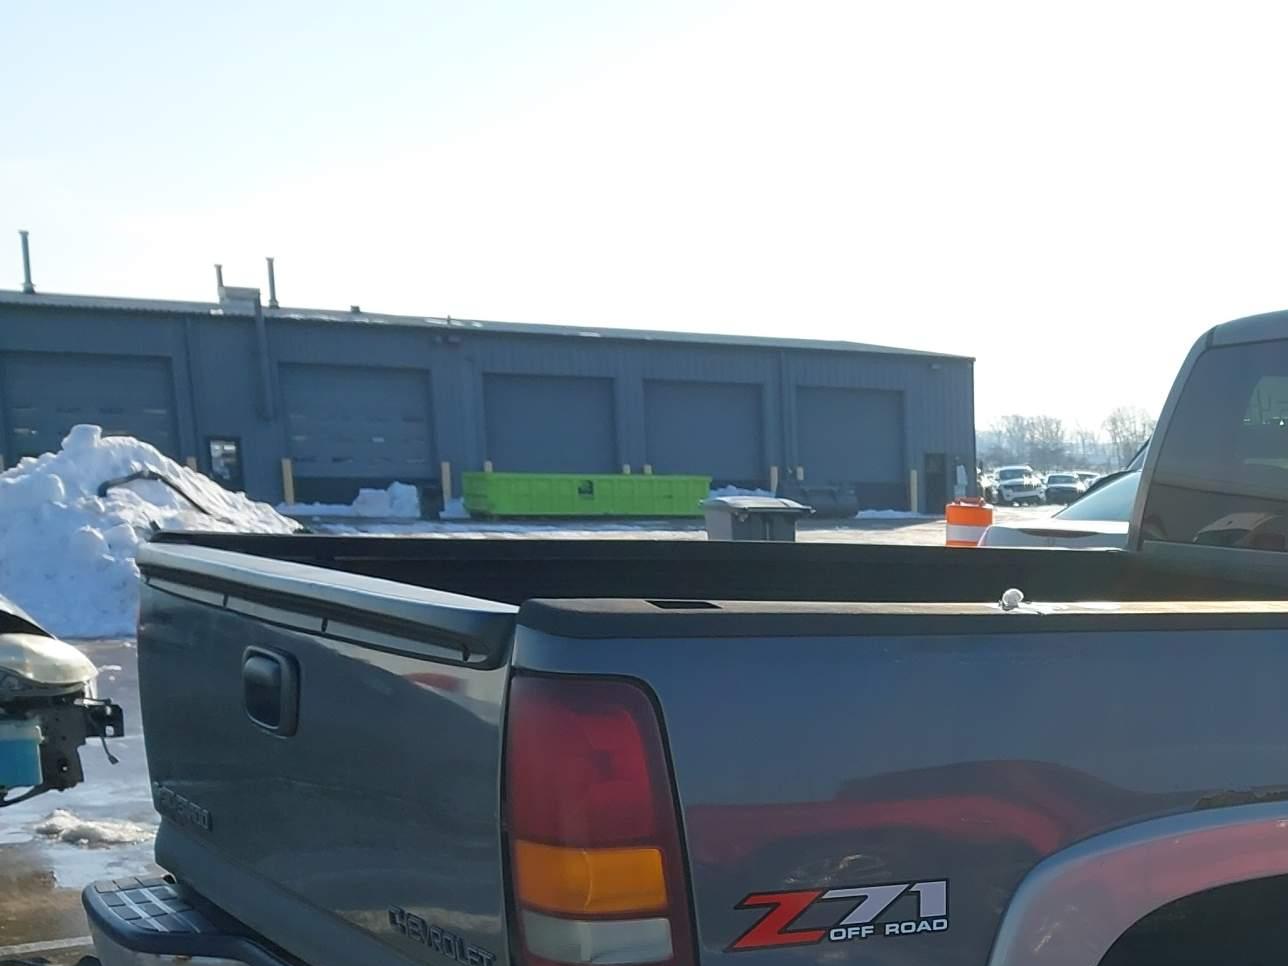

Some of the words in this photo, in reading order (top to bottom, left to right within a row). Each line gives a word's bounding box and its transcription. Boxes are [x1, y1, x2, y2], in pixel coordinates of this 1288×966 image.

[731, 879, 949, 950] Z71
[829, 925, 875, 942] OFF
[884, 918, 948, 936] ROAD
